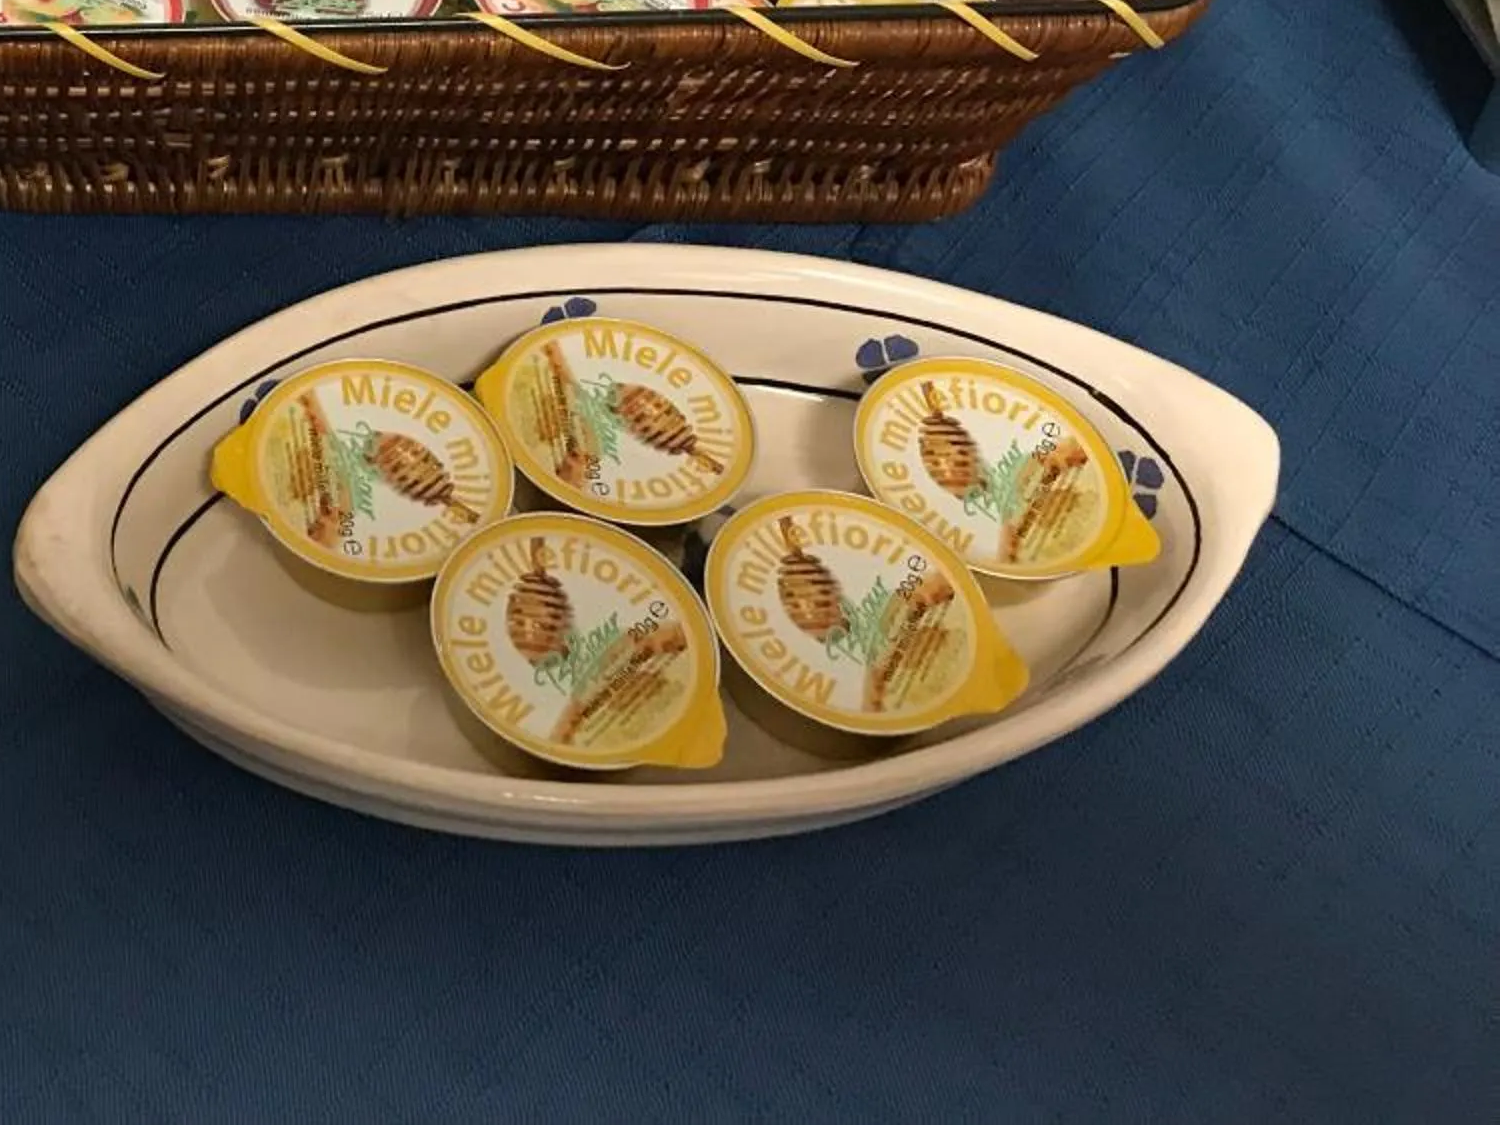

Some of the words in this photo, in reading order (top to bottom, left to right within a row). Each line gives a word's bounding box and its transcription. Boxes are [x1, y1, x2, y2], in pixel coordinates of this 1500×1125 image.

[581, 328, 693, 390] Miele
[341, 374, 451, 434] Miele
[881, 459, 976, 554] Miele
[450, 614, 536, 724] Miele
[627, 616, 661, 646] 20g
[740, 604, 839, 706] Miele
